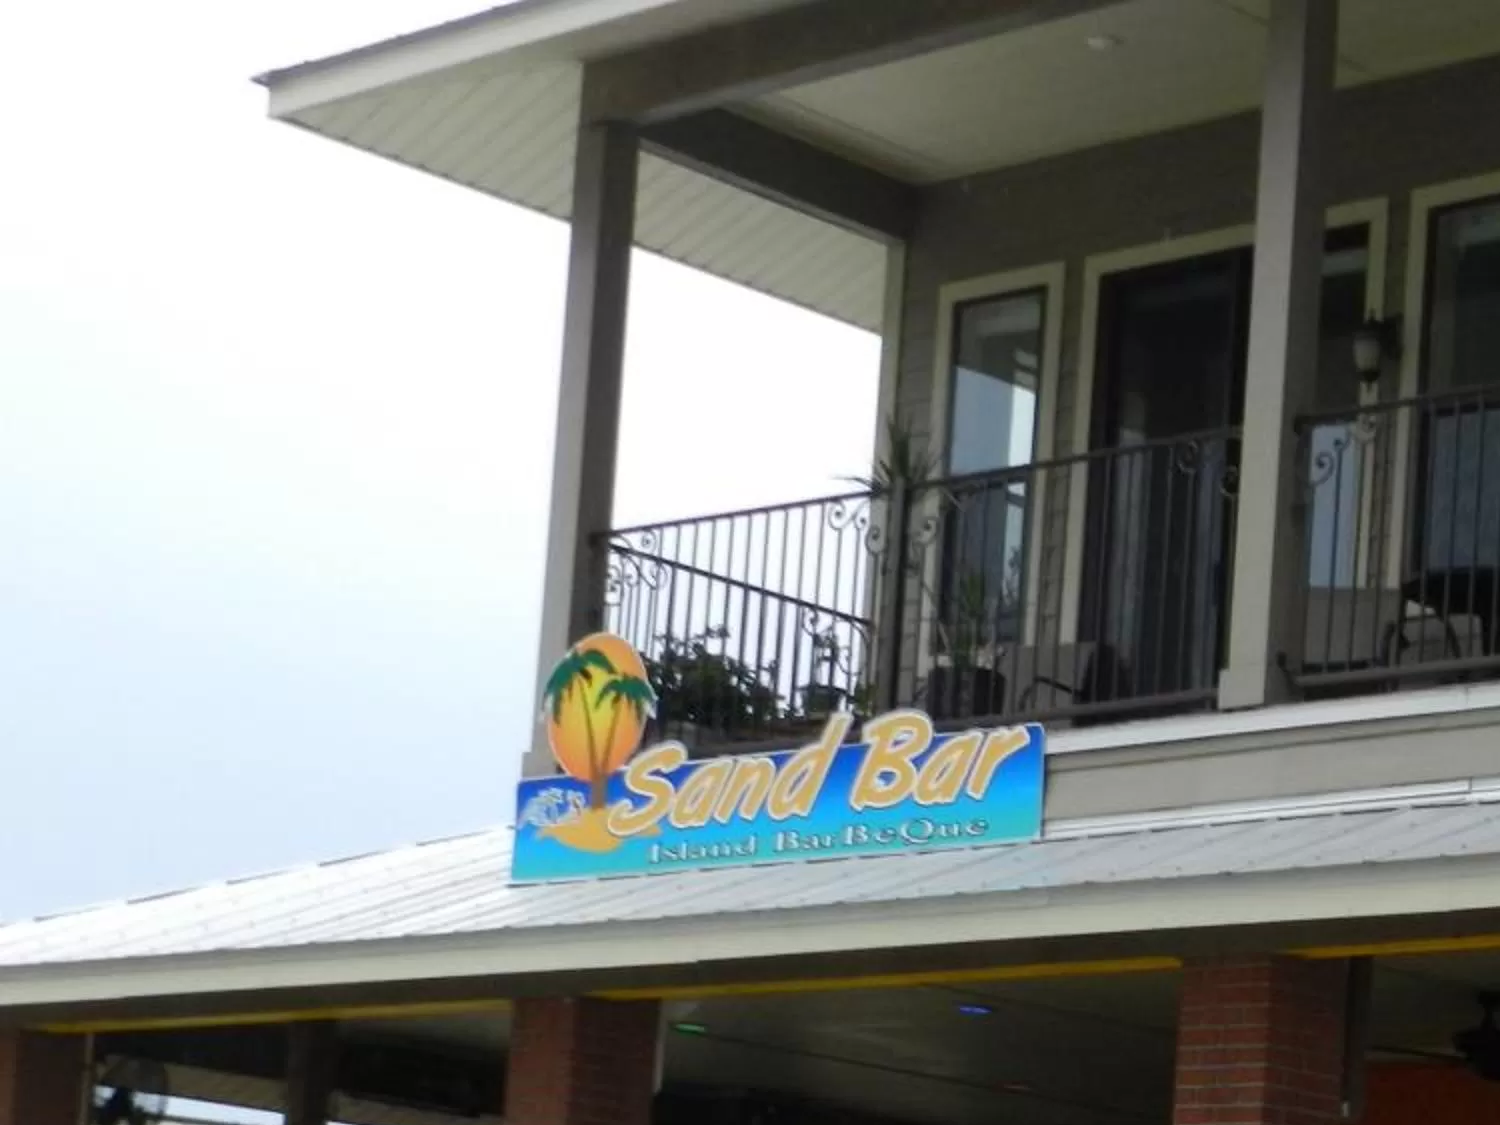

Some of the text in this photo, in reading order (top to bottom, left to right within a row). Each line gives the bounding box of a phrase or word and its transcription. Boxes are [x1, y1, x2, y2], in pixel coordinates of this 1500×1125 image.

[607, 709, 1031, 837] Sand Bar
[649, 834, 757, 864] Island
